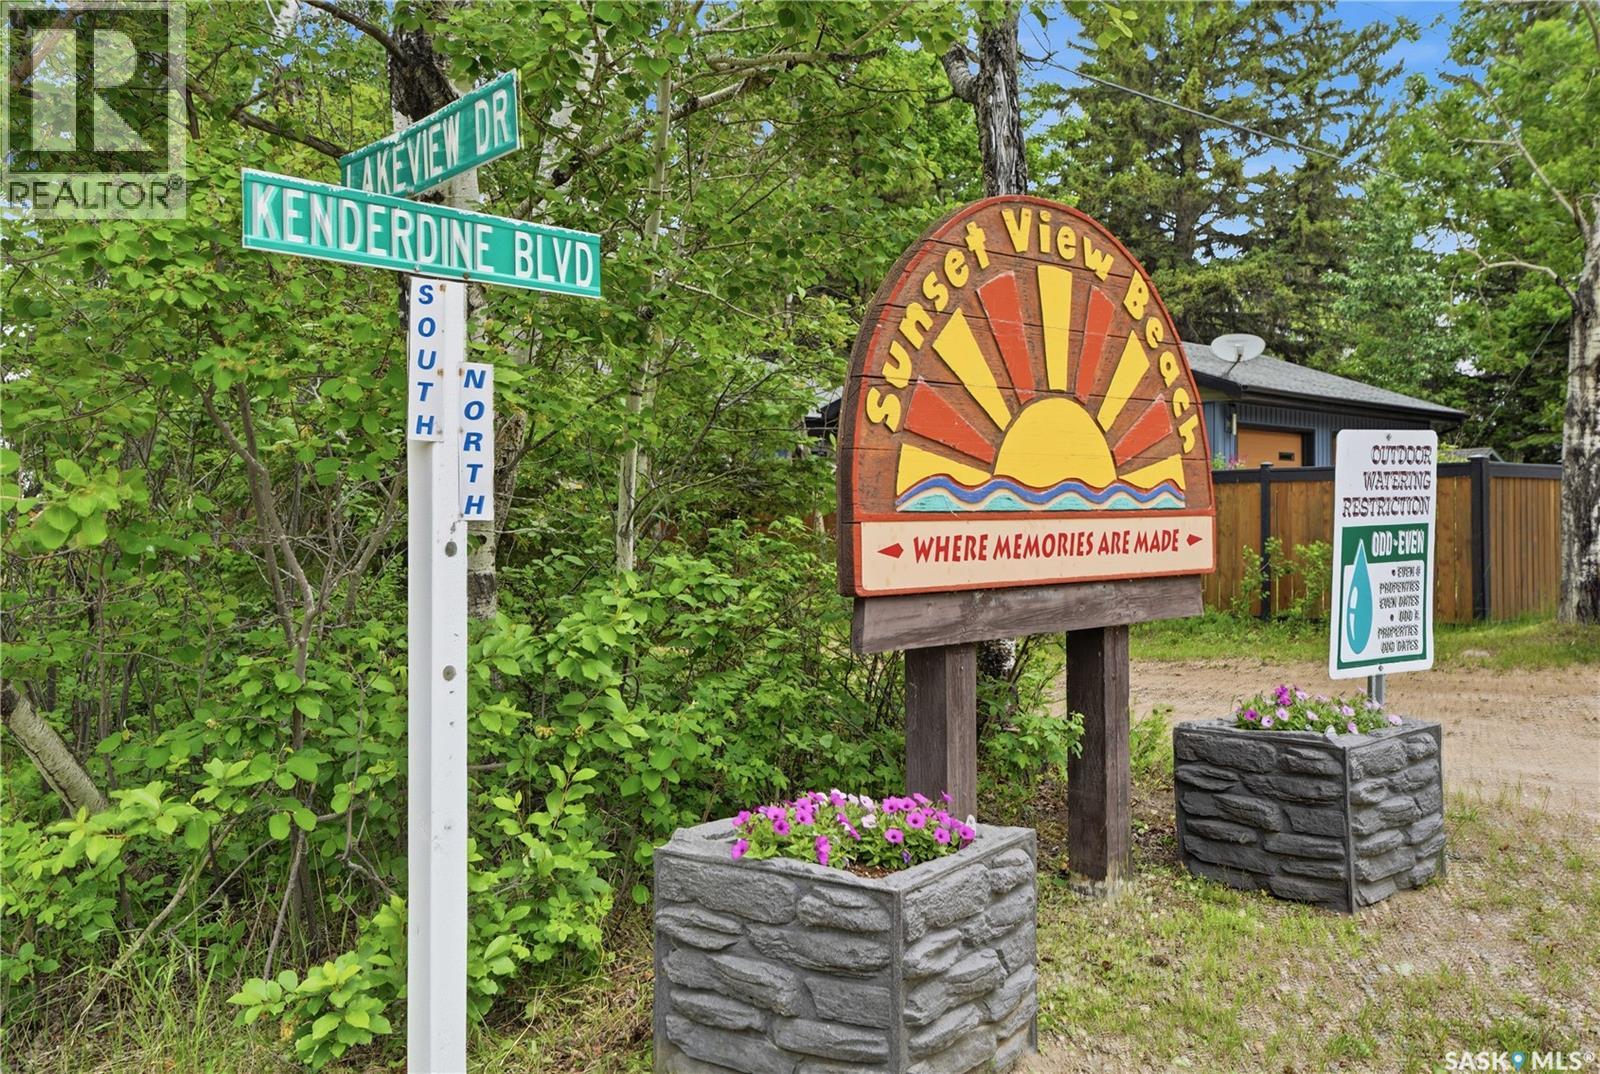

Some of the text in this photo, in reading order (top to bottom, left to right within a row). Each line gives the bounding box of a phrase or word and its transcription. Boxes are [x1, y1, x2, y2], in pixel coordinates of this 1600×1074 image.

[474, 88, 510, 155] DR
[250, 183, 595, 287] KENDERDINE BLVD
[416, 283, 436, 438] SOUTH
[865, 206, 1199, 455] Sunset View Beach
[462, 369, 487, 516] NORTH
[1371, 444, 1432, 466] OUTDOOR
[1342, 496, 1431, 518] RESTRICTION
[1363, 470, 1432, 491] WATERING
[913, 528, 1180, 563] WHERE MEMORIES ARE MADE
